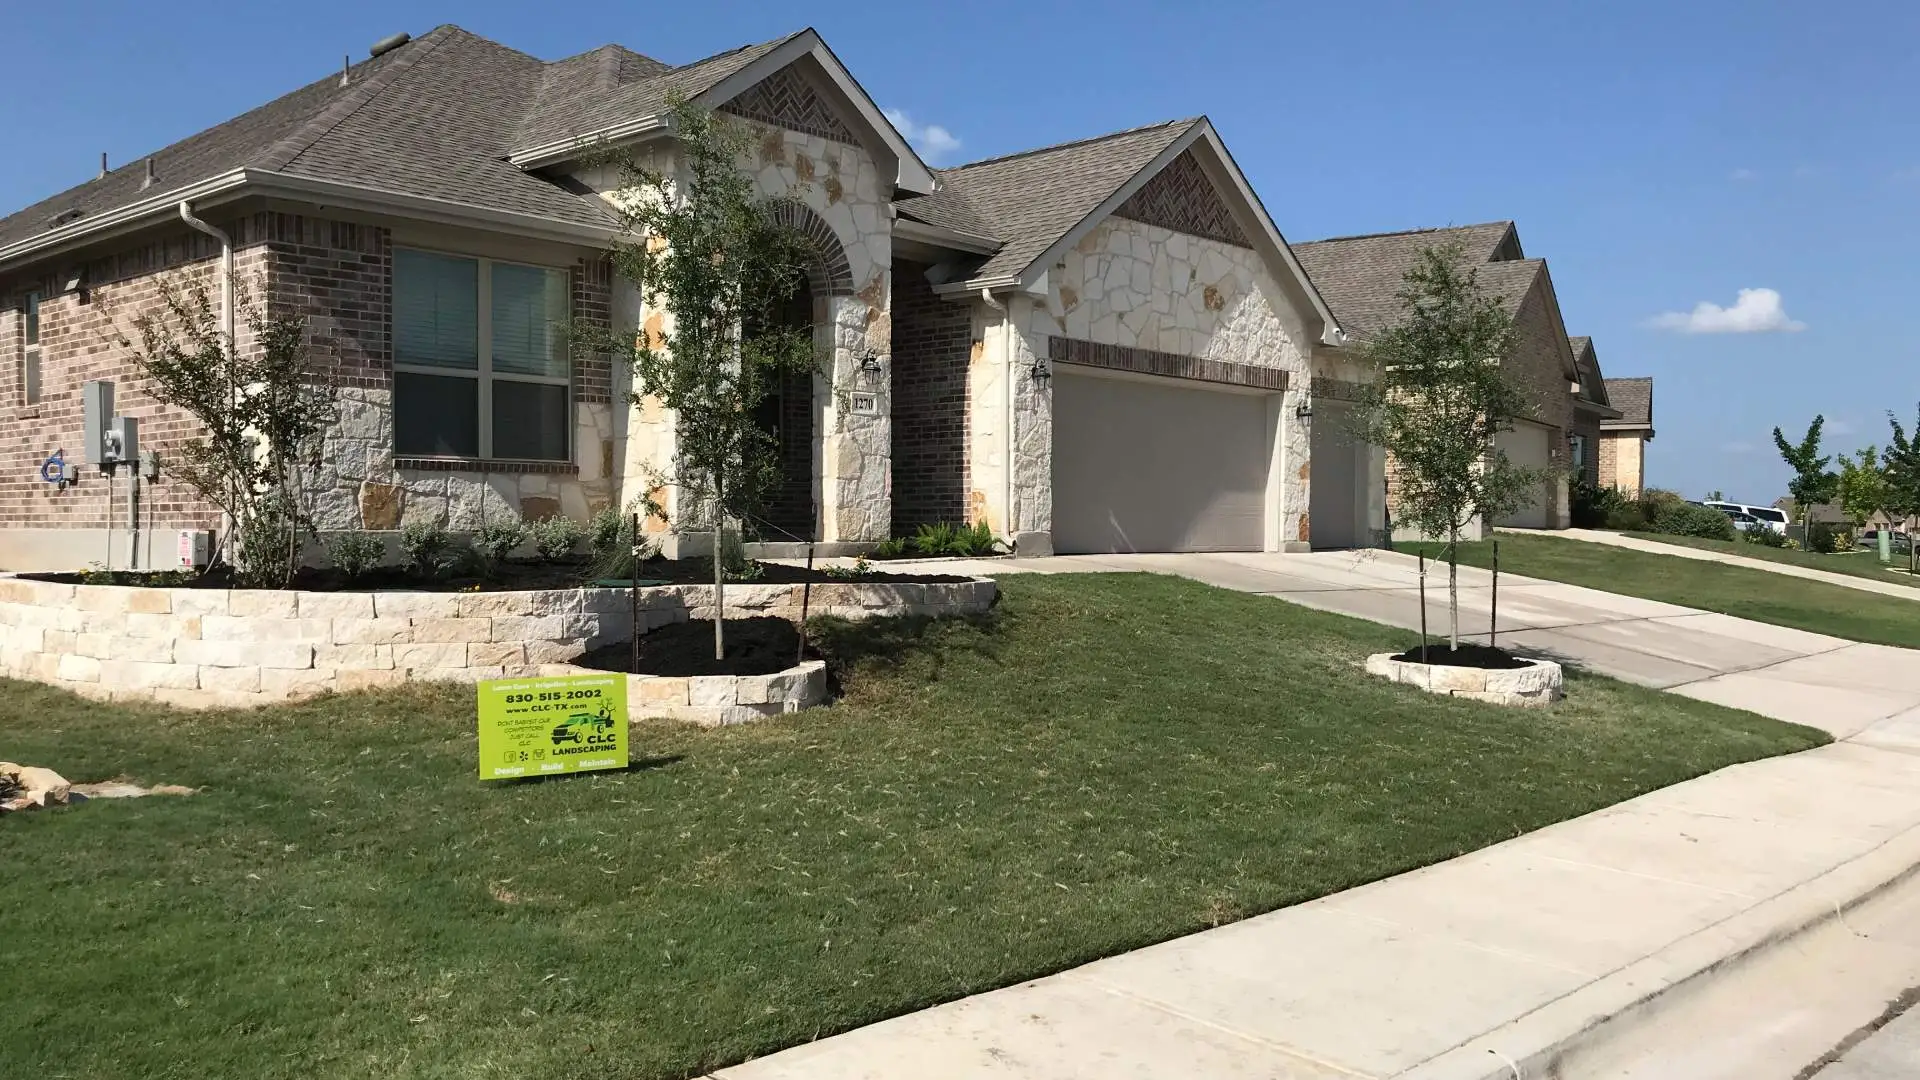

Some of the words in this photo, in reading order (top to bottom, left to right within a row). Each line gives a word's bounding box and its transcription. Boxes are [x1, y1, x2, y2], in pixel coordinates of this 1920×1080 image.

[855, 398, 873, 410] 1270
[587, 733, 616, 744] CLC
[552, 744, 617, 756] LANDSCAPING
[495, 766, 525, 776] Design
[541, 762, 564, 771] Build
[579, 758, 616, 768] Maintain
